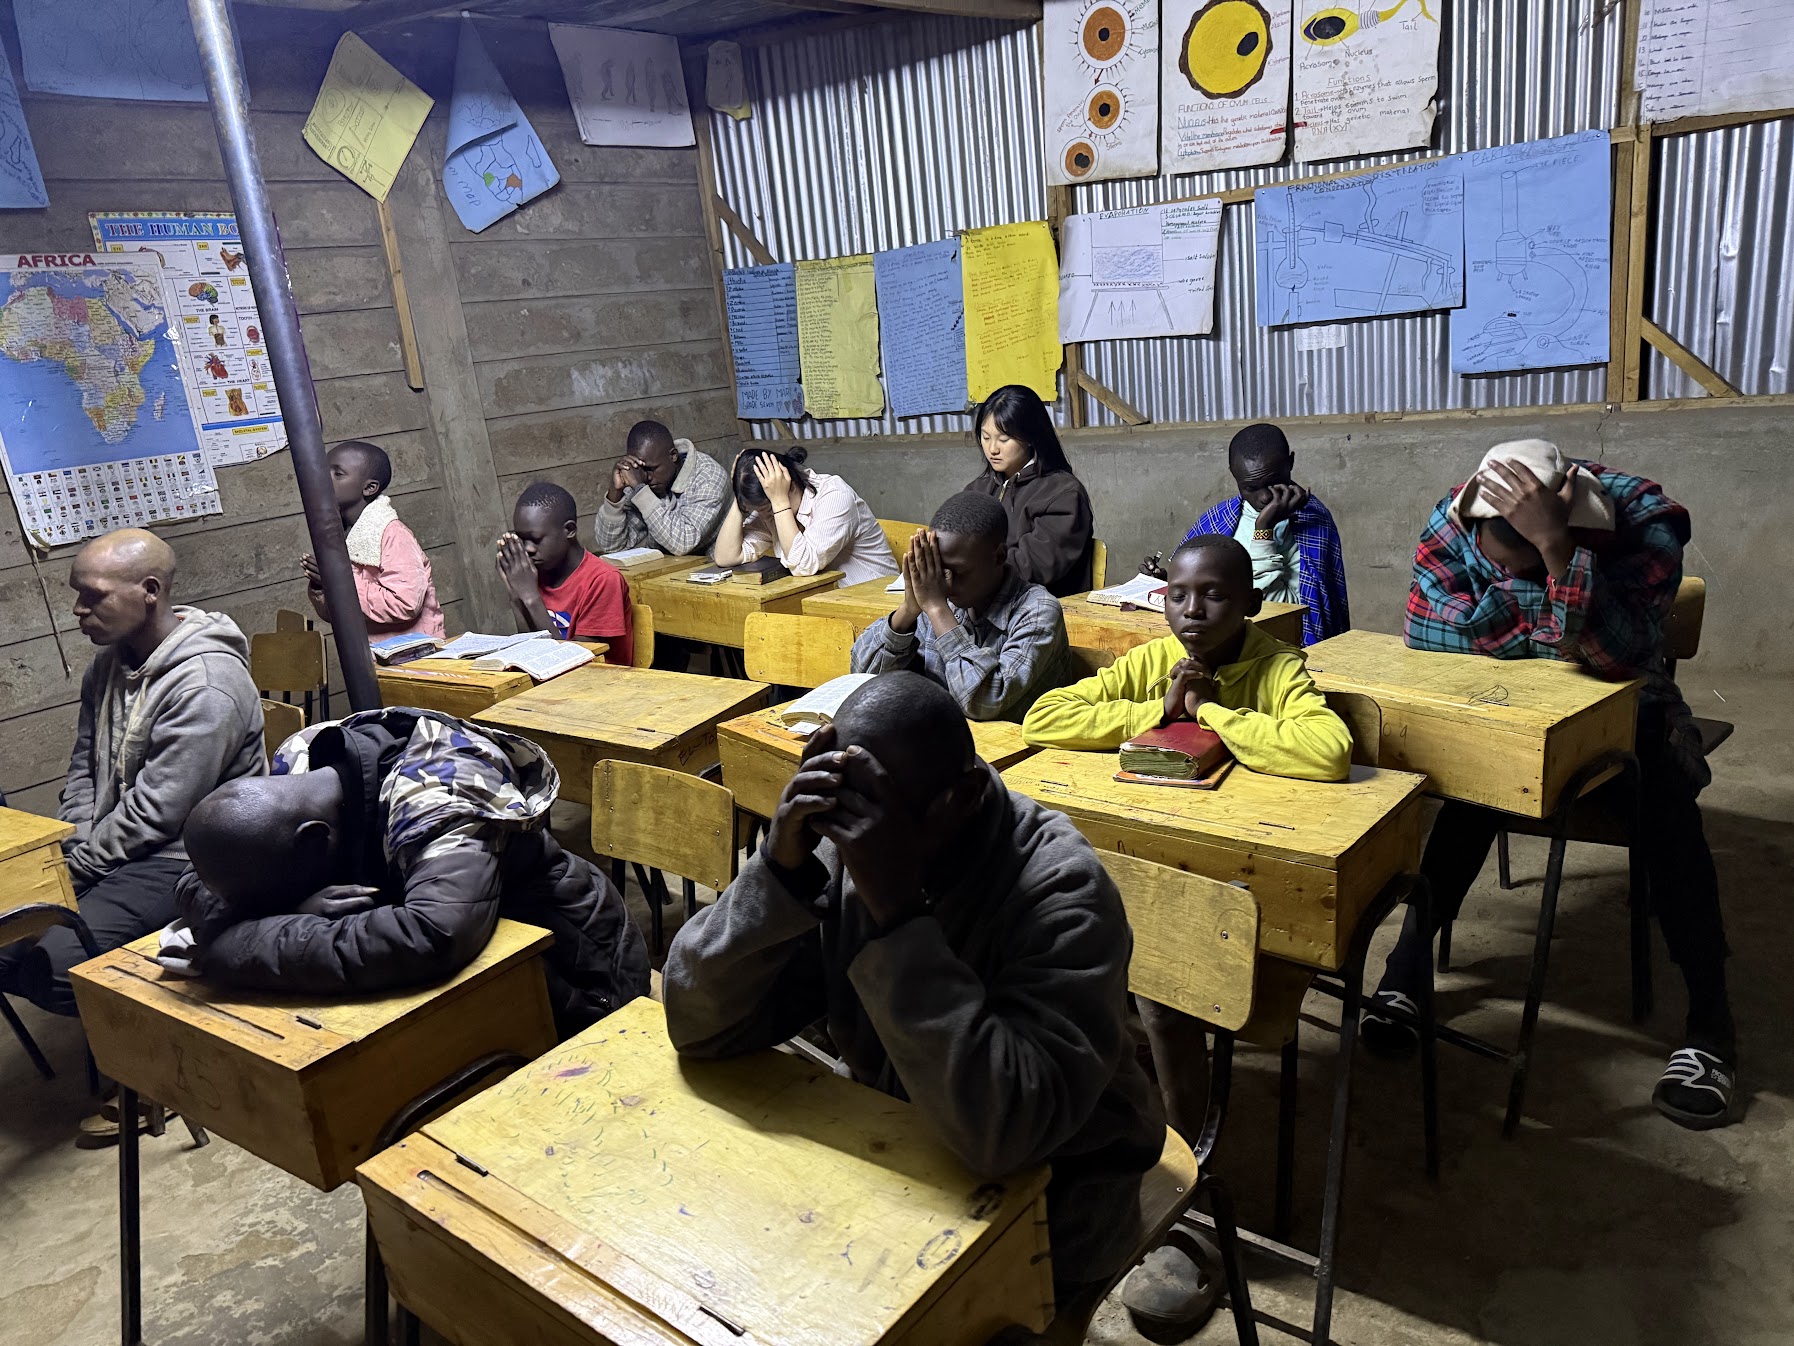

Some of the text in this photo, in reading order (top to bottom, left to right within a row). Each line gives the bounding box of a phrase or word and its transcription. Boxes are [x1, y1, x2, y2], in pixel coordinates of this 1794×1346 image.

[1399, 20, 1418, 31] Tail
[1345, 48, 1373, 58] Nucleus
[1327, 74, 1372, 87] Functions
[1377, 79, 1392, 88] that
[1178, 102, 1214, 113] FUNCTIONS
[1218, 101, 1228, 109] OF
[1229, 99, 1248, 107] OVUM
[1379, 108, 1410, 117] material
[1099, 207, 1150, 220] EVAPORATION
[105, 222, 240, 236] THE HUMAN BO
[17, 254, 97, 268] AFRICA
[742, 388, 759, 401] MADE
[763, 388, 772, 400] BY
